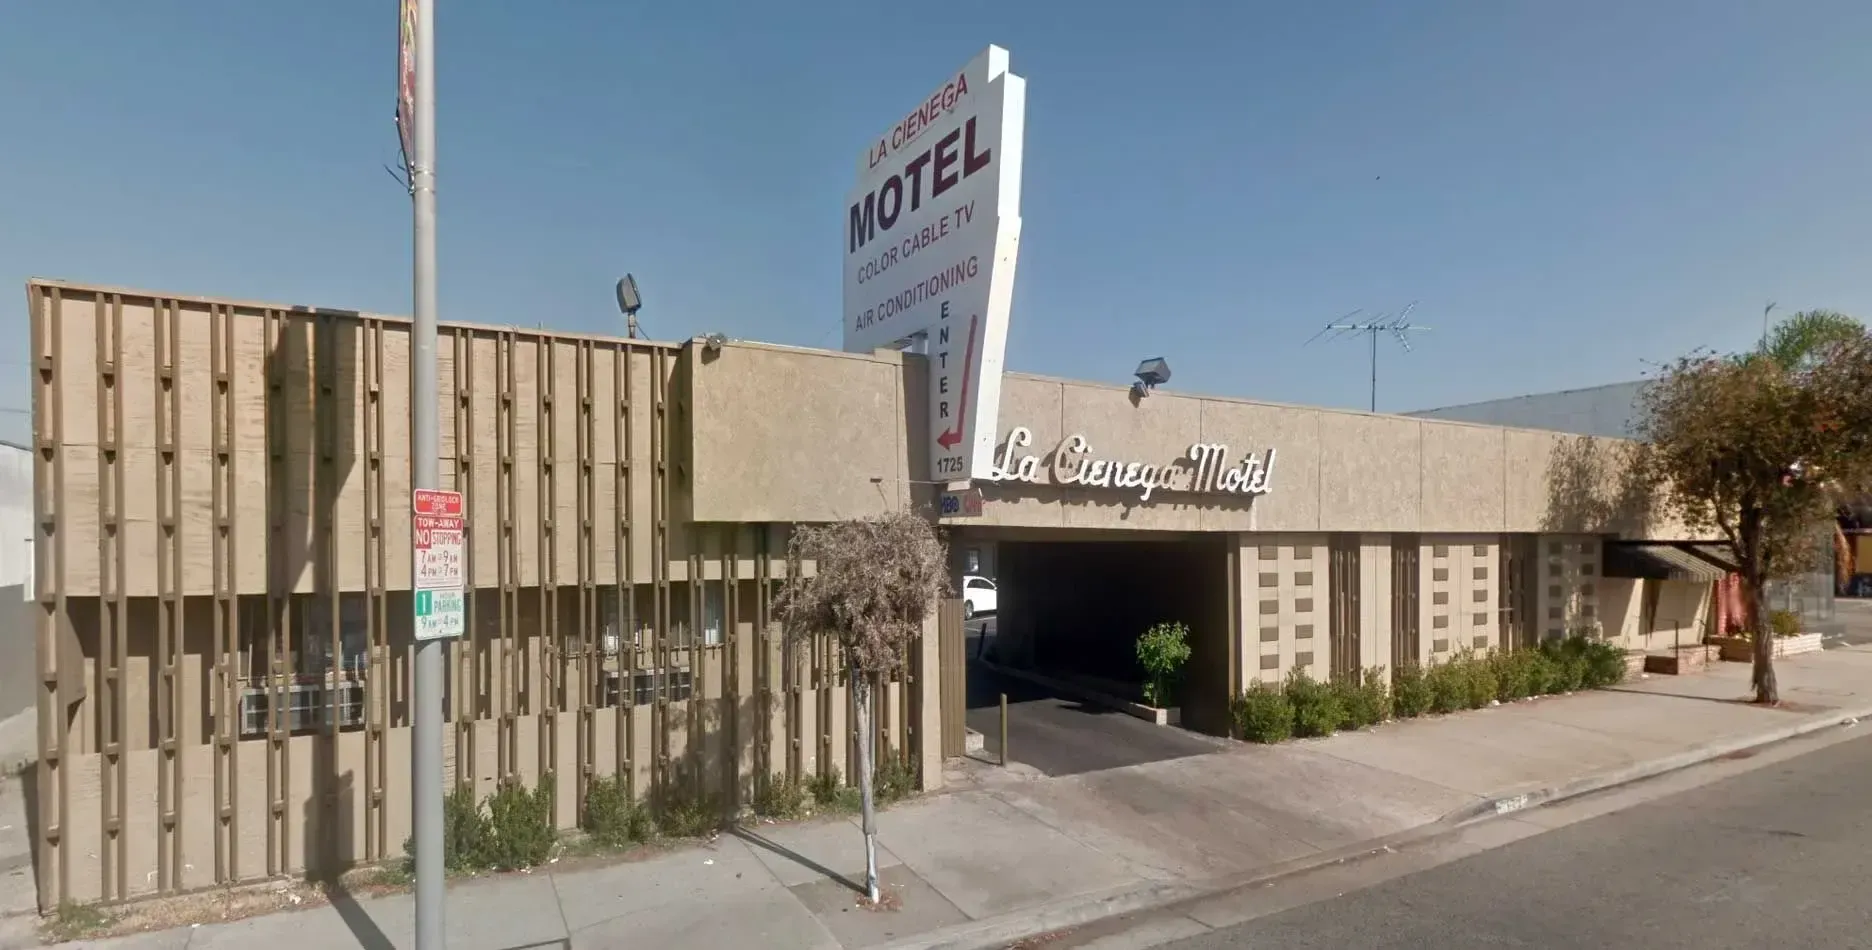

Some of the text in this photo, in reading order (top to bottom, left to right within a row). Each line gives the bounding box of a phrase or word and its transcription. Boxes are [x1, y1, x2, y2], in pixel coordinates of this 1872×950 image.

[869, 73, 969, 169] LA CIENEGA
[850, 116, 992, 253] MOTEL
[858, 200, 975, 285] COLOR CABLE TV
[855, 255, 978, 332] AIR CONDITIONING
[939, 300, 950, 418] ENTER
[937, 456, 963, 473] 1725
[992, 427, 1276, 500] La Cienega Motel
[416, 529, 461, 545] NO STOPPING
[418, 518, 460, 529] TOW-AWAY
[434, 600, 461, 613] PARKING
